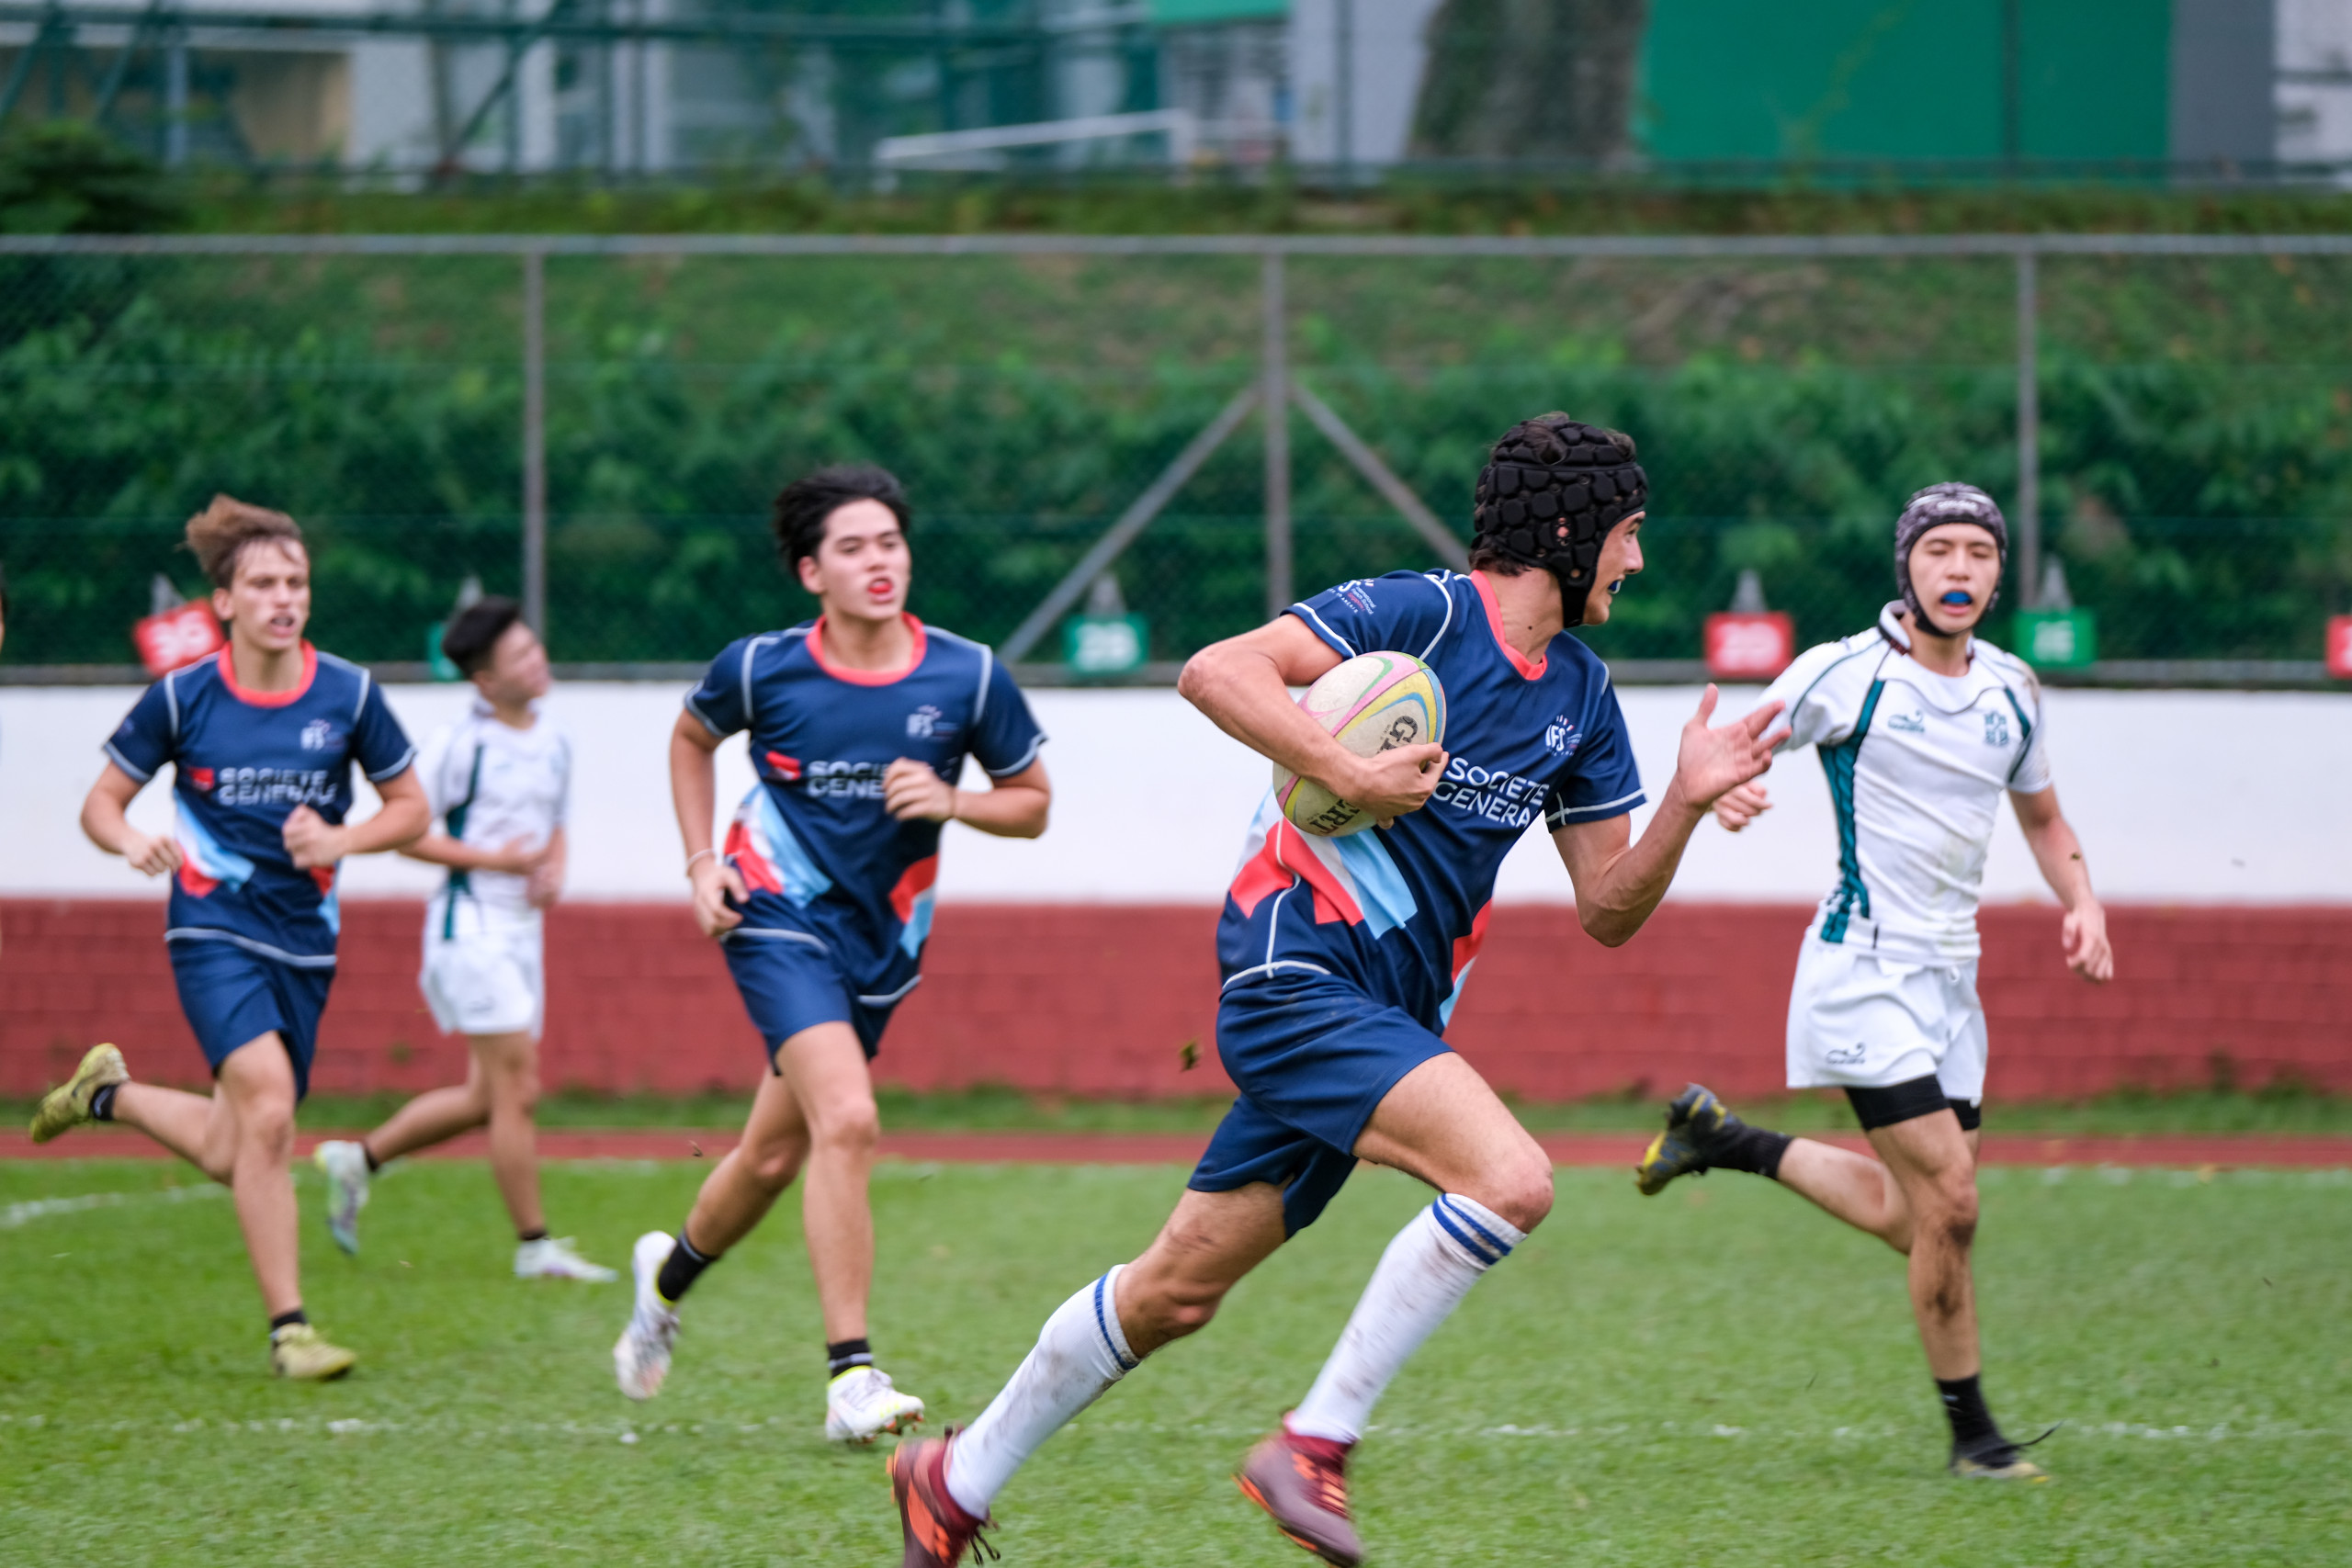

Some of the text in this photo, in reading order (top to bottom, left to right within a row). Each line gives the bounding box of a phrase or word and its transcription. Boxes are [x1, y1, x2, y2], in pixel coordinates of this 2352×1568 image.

[1545, 724, 1566, 751] IFS
[808, 760, 890, 778] SOCIE
[1445, 757, 1550, 807] SOCIETE
[807, 777, 888, 799] GENE
[1431, 781, 1532, 829] GENERA
